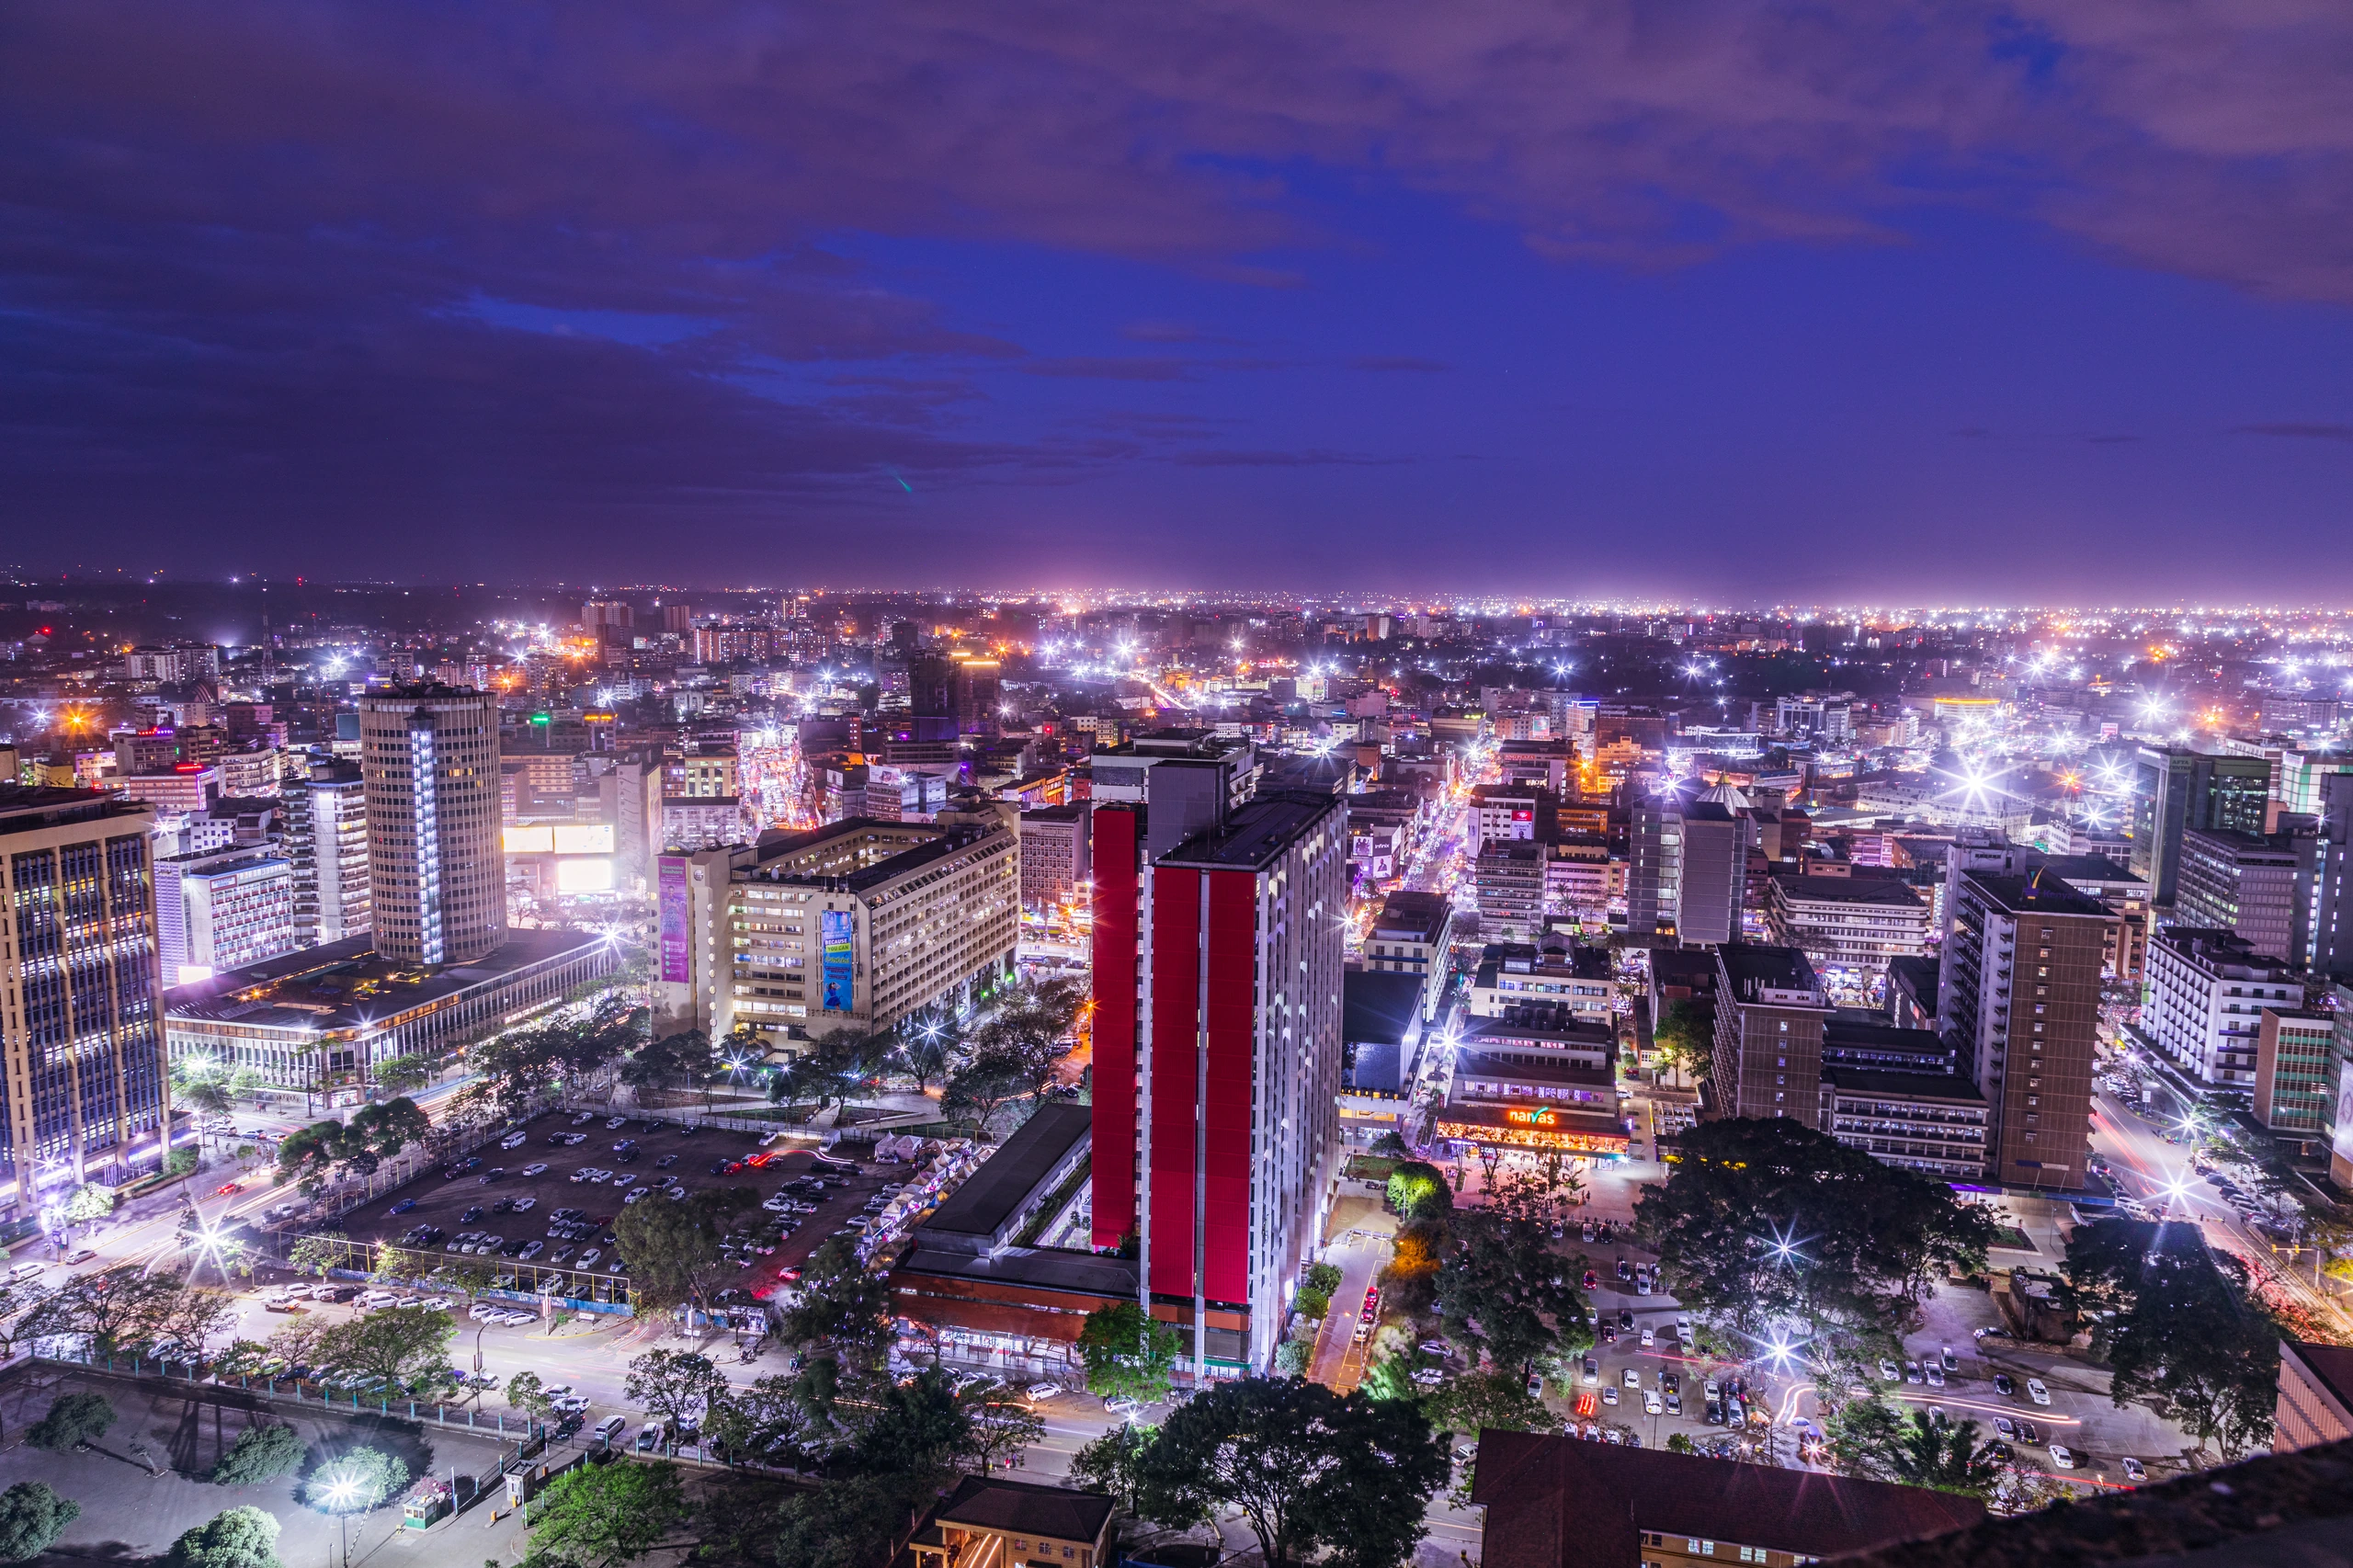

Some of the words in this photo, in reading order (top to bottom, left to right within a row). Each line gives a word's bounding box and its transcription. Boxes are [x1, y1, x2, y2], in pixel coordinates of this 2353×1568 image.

[2043, 889, 2073, 901] Kenya
[824, 937, 847, 946] BECAUSE
[1509, 1106, 1555, 1125] naivas
